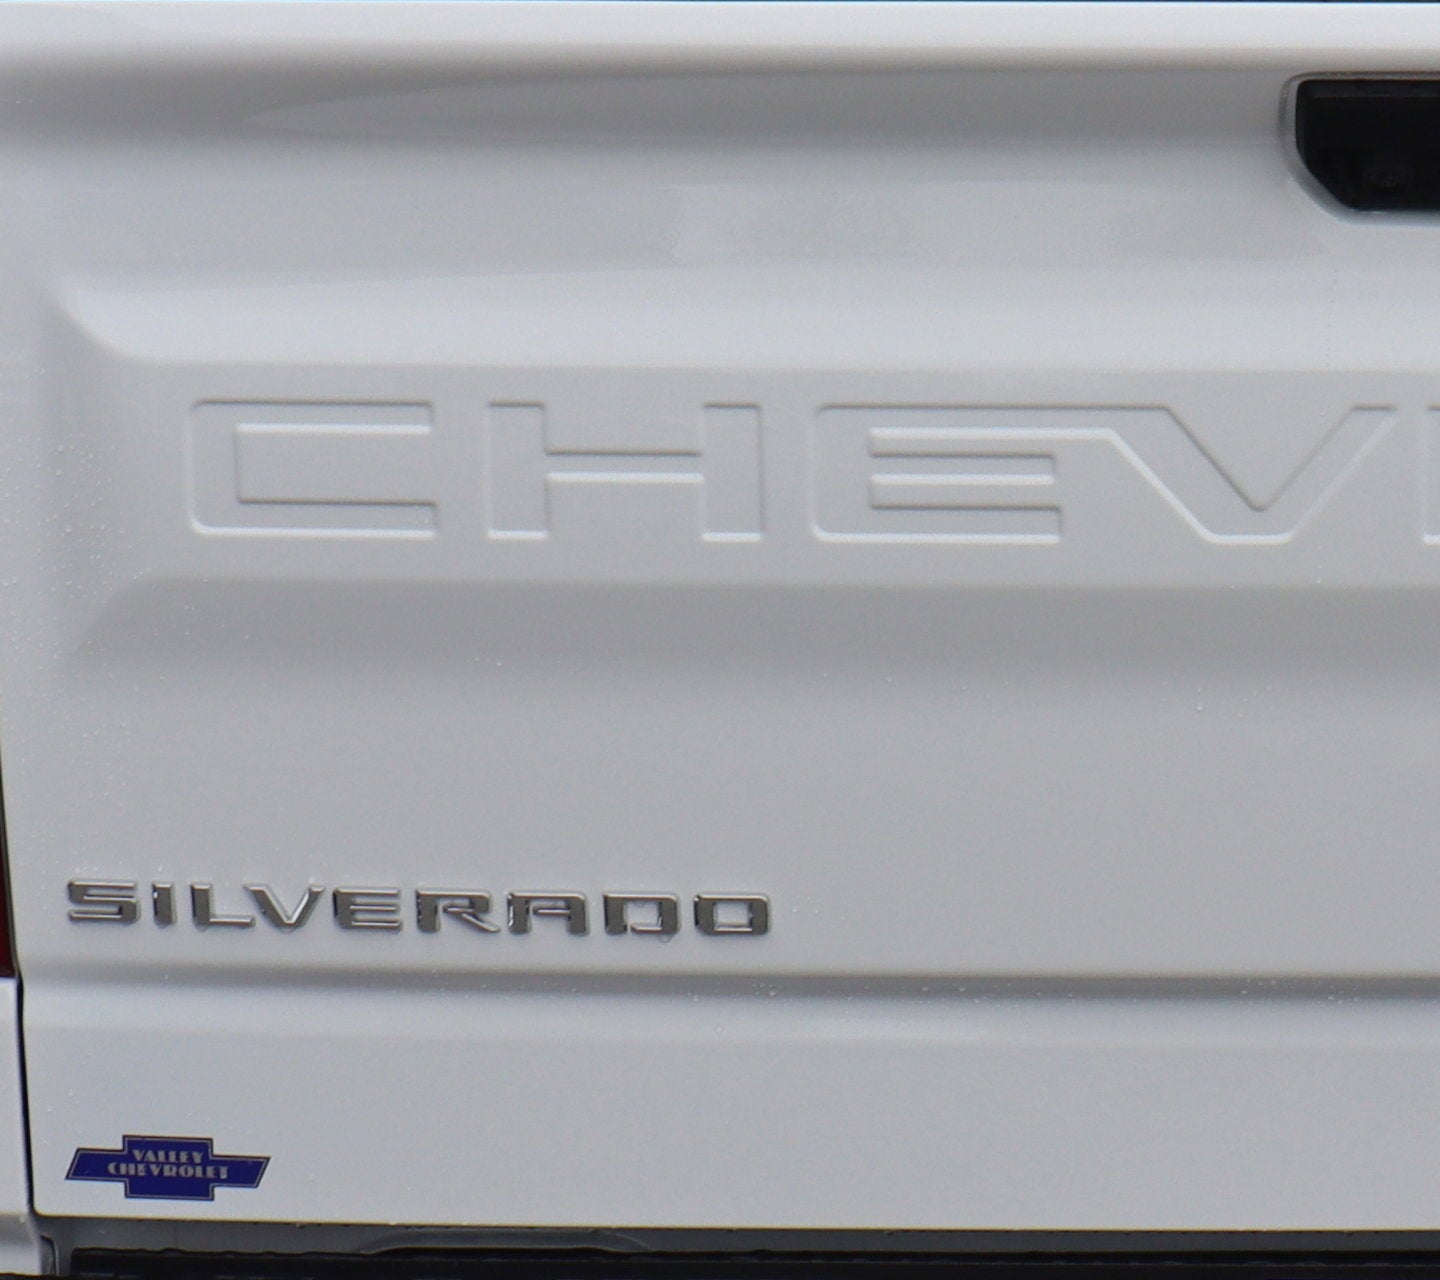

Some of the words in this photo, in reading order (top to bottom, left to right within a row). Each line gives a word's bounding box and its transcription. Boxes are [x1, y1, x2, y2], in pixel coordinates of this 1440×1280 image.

[66, 878, 771, 936] SILVERADO
[132, 1149, 204, 1164] VALLEY
[107, 1162, 229, 1179] CHEVROLET
